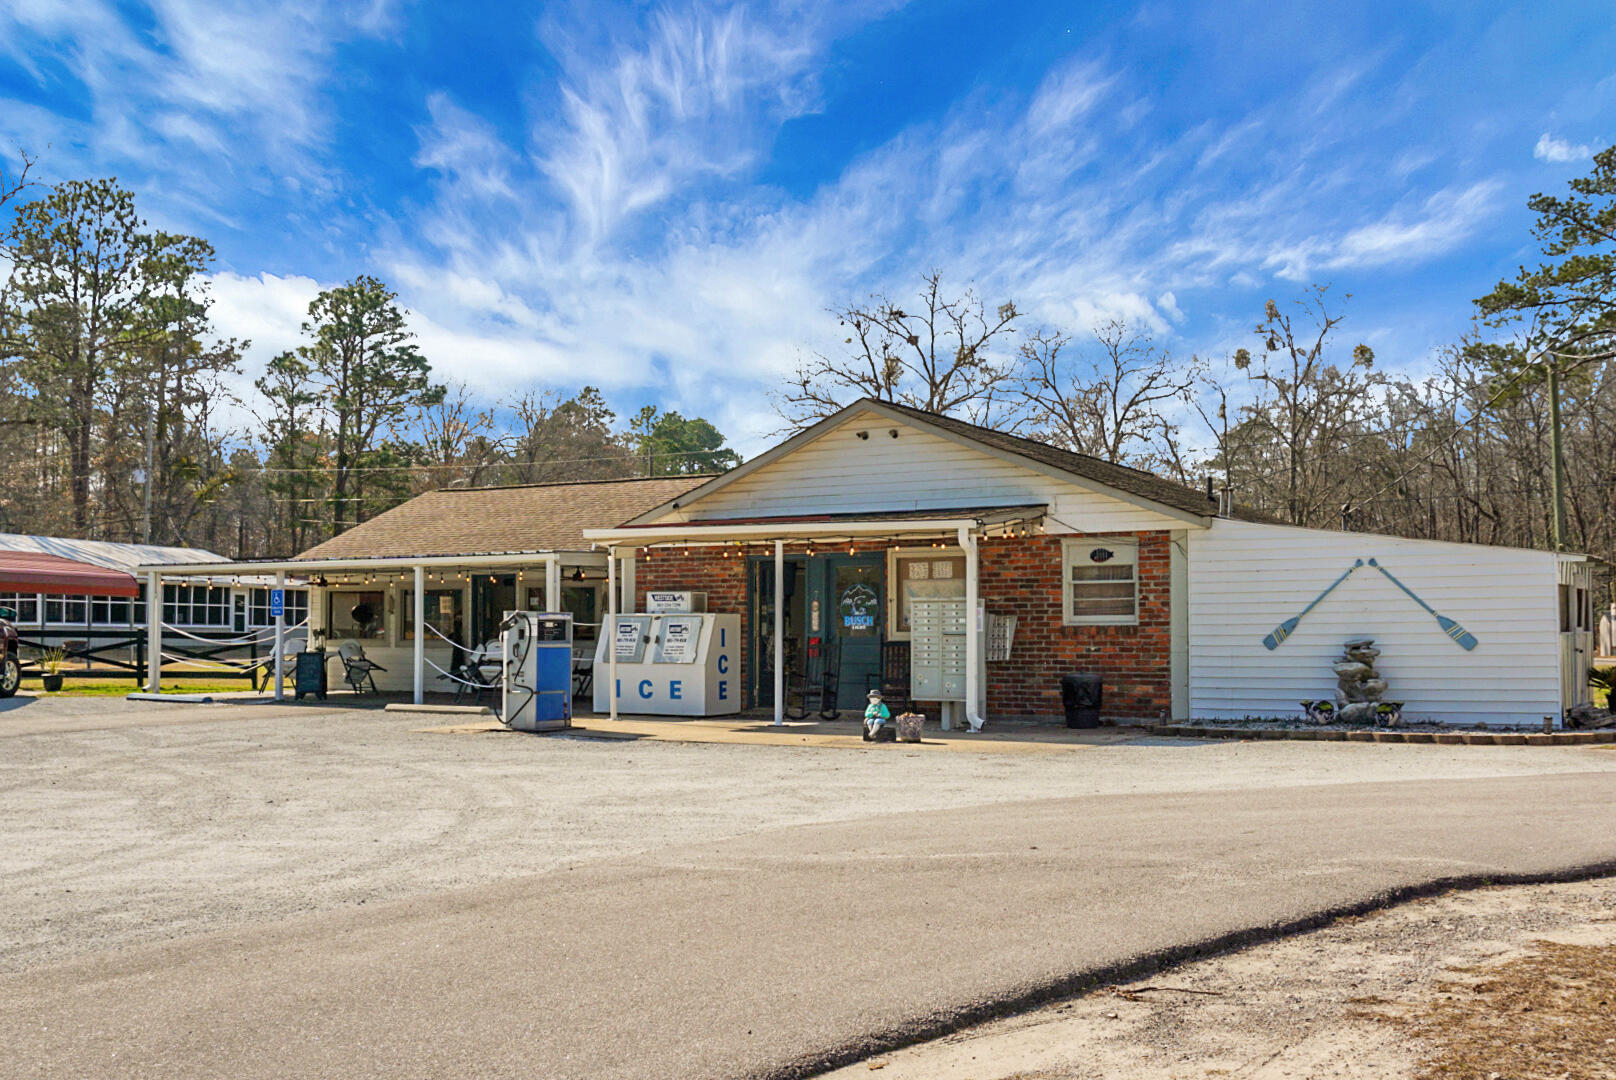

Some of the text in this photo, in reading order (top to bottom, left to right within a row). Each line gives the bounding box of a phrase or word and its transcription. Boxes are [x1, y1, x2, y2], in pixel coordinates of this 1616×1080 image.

[844, 615, 874, 627] BUSCH
[718, 627, 729, 701] ICE
[615, 678, 683, 700] ICE
